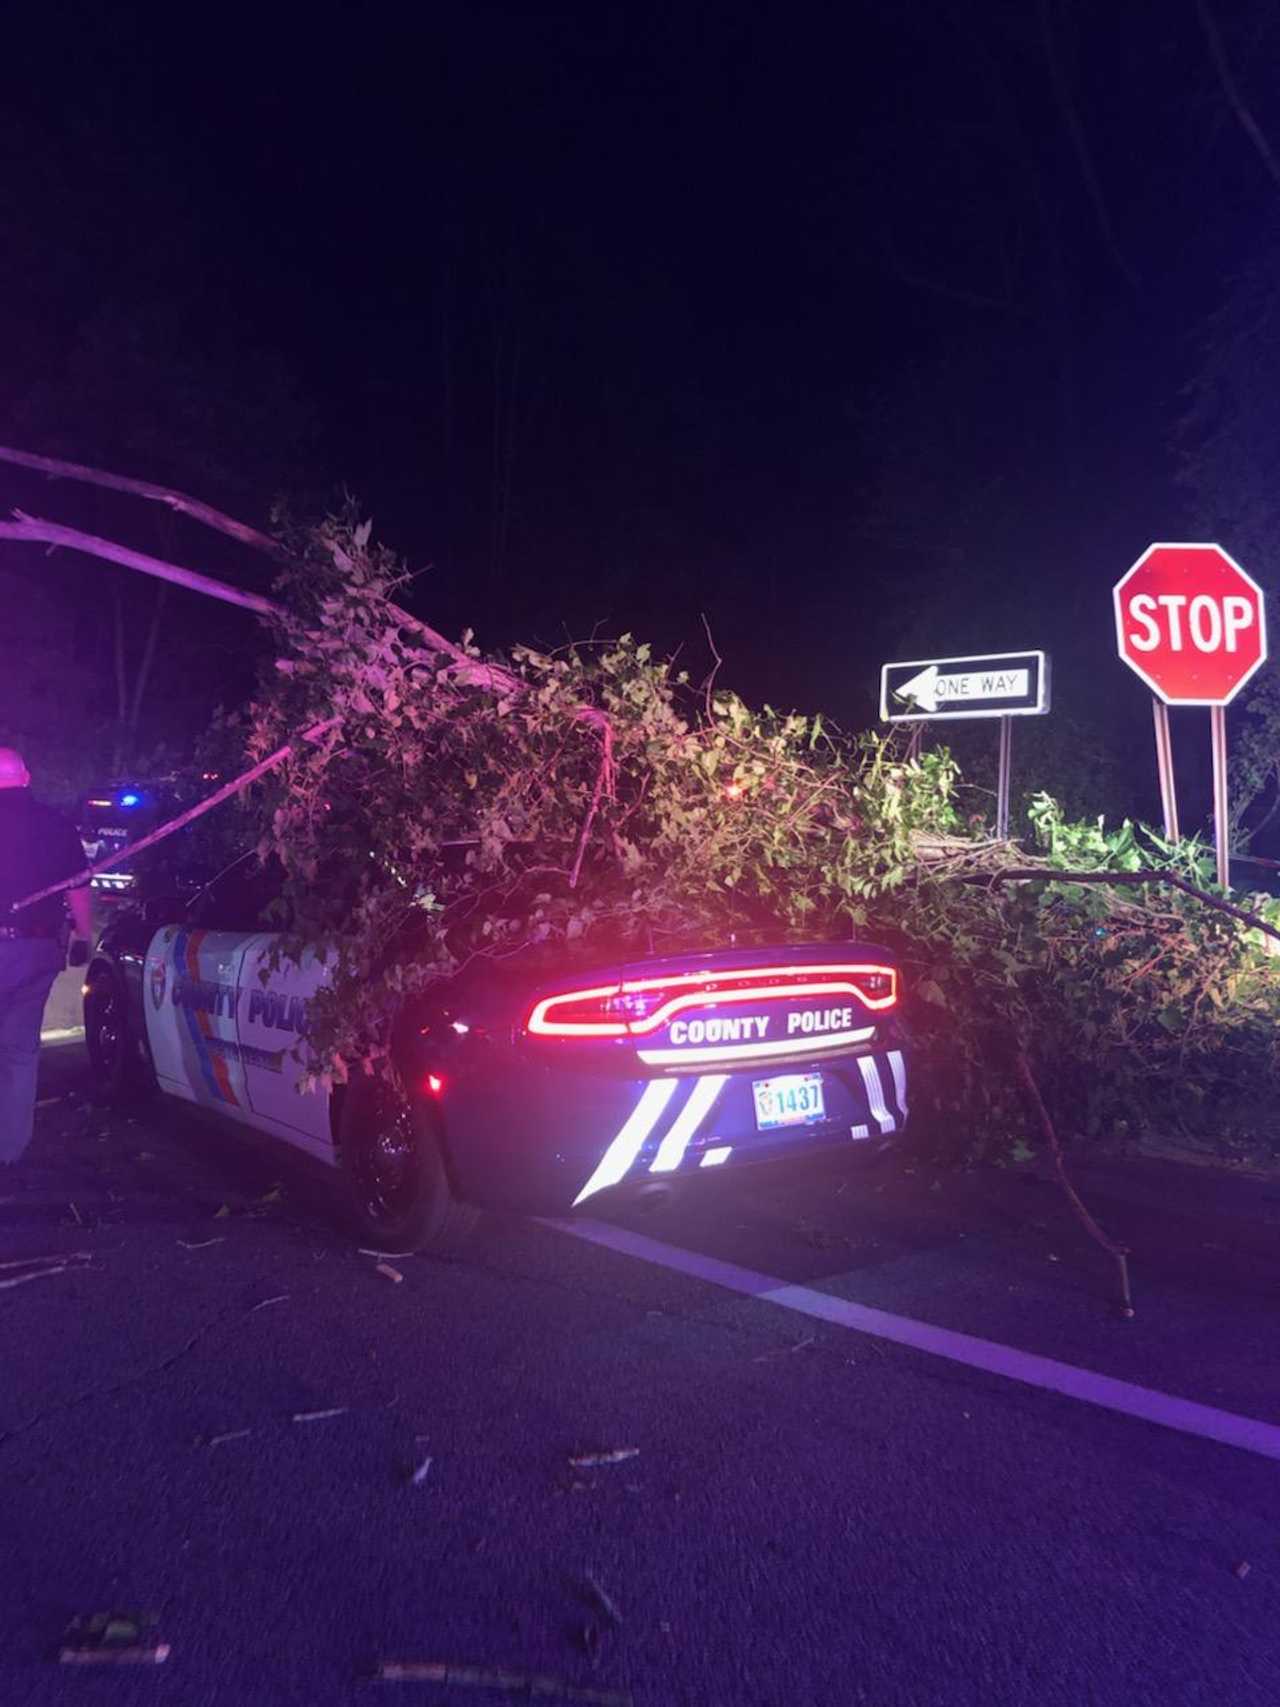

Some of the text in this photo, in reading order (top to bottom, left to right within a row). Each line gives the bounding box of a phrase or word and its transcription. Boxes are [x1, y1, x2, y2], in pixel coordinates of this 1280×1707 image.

[1129, 594, 1253, 653] STOP
[935, 673, 1019, 697] ONE WAY
[249, 989, 311, 1034] POLIC
[670, 1008, 852, 1044] COUNTY POLICE
[776, 1085, 818, 1114] 1437
